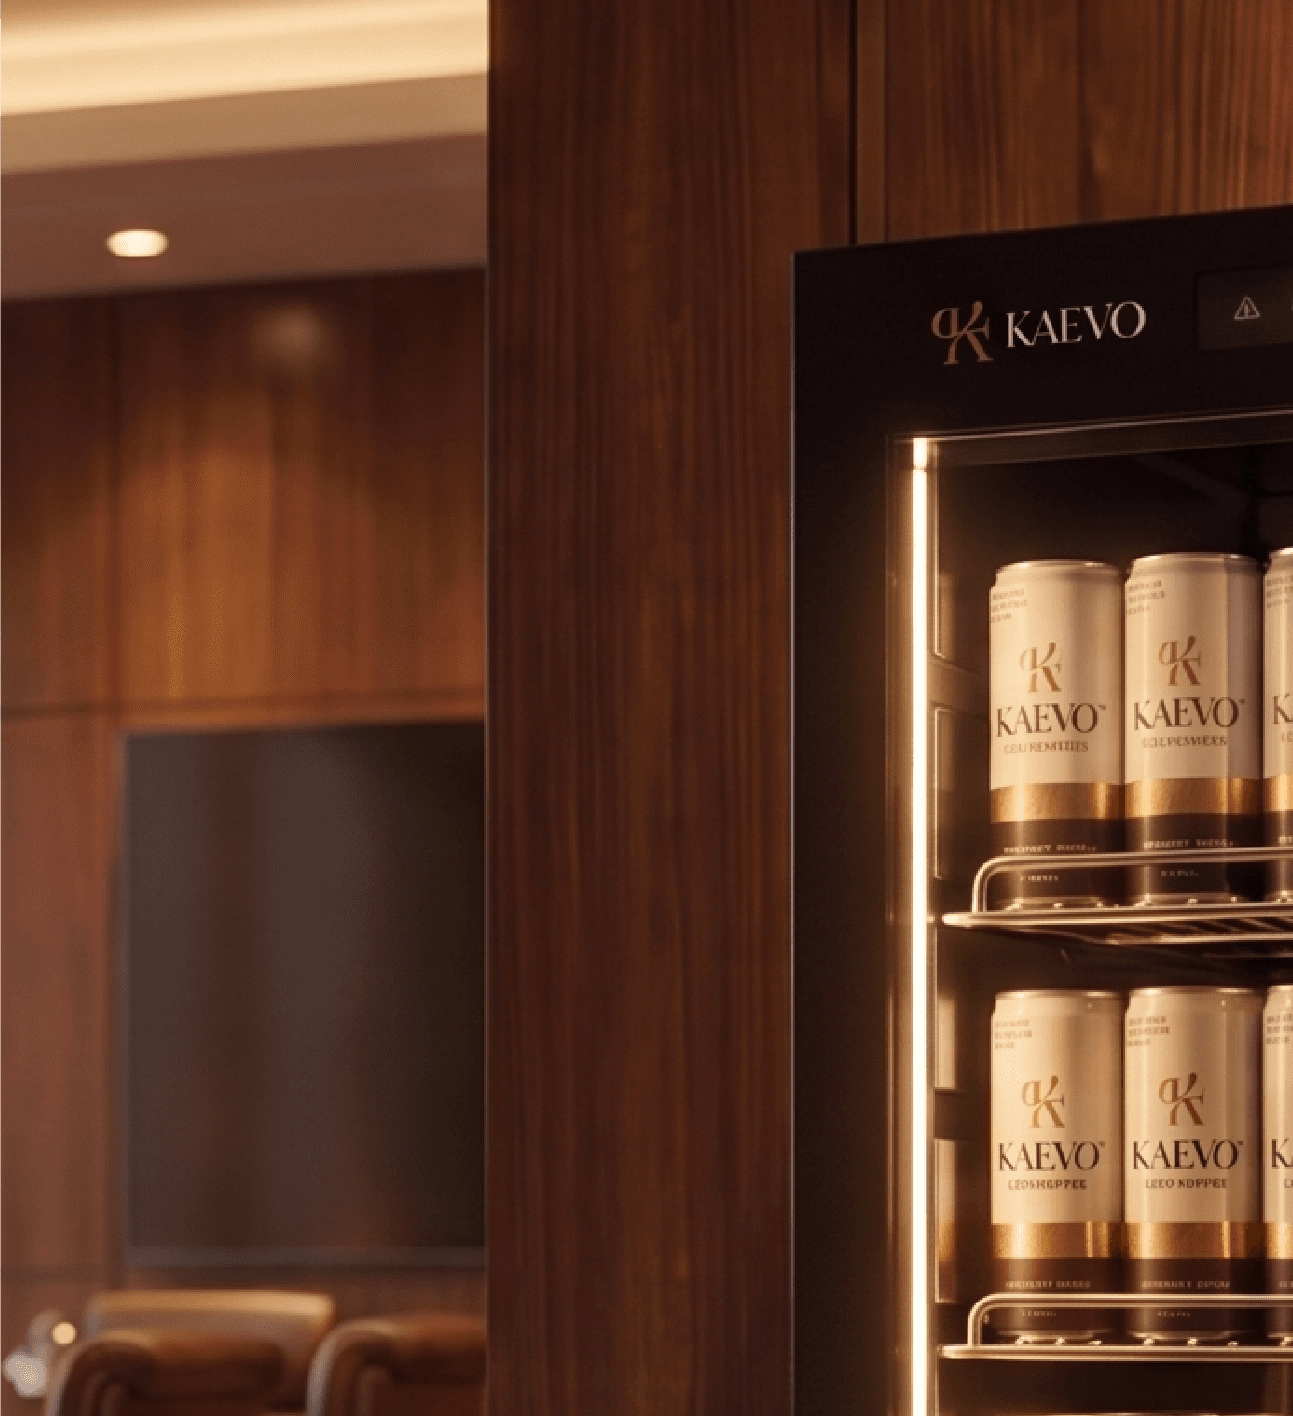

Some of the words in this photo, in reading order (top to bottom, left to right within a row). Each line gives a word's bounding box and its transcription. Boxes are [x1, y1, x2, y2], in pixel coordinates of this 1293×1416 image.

[1006, 301, 1147, 348] KAEVO
[997, 703, 1098, 737] KAEVO
[1133, 697, 1239, 731] KAEVO
[998, 1140, 1100, 1171] KAEVO
[1133, 1139, 1239, 1170] KAEVO
